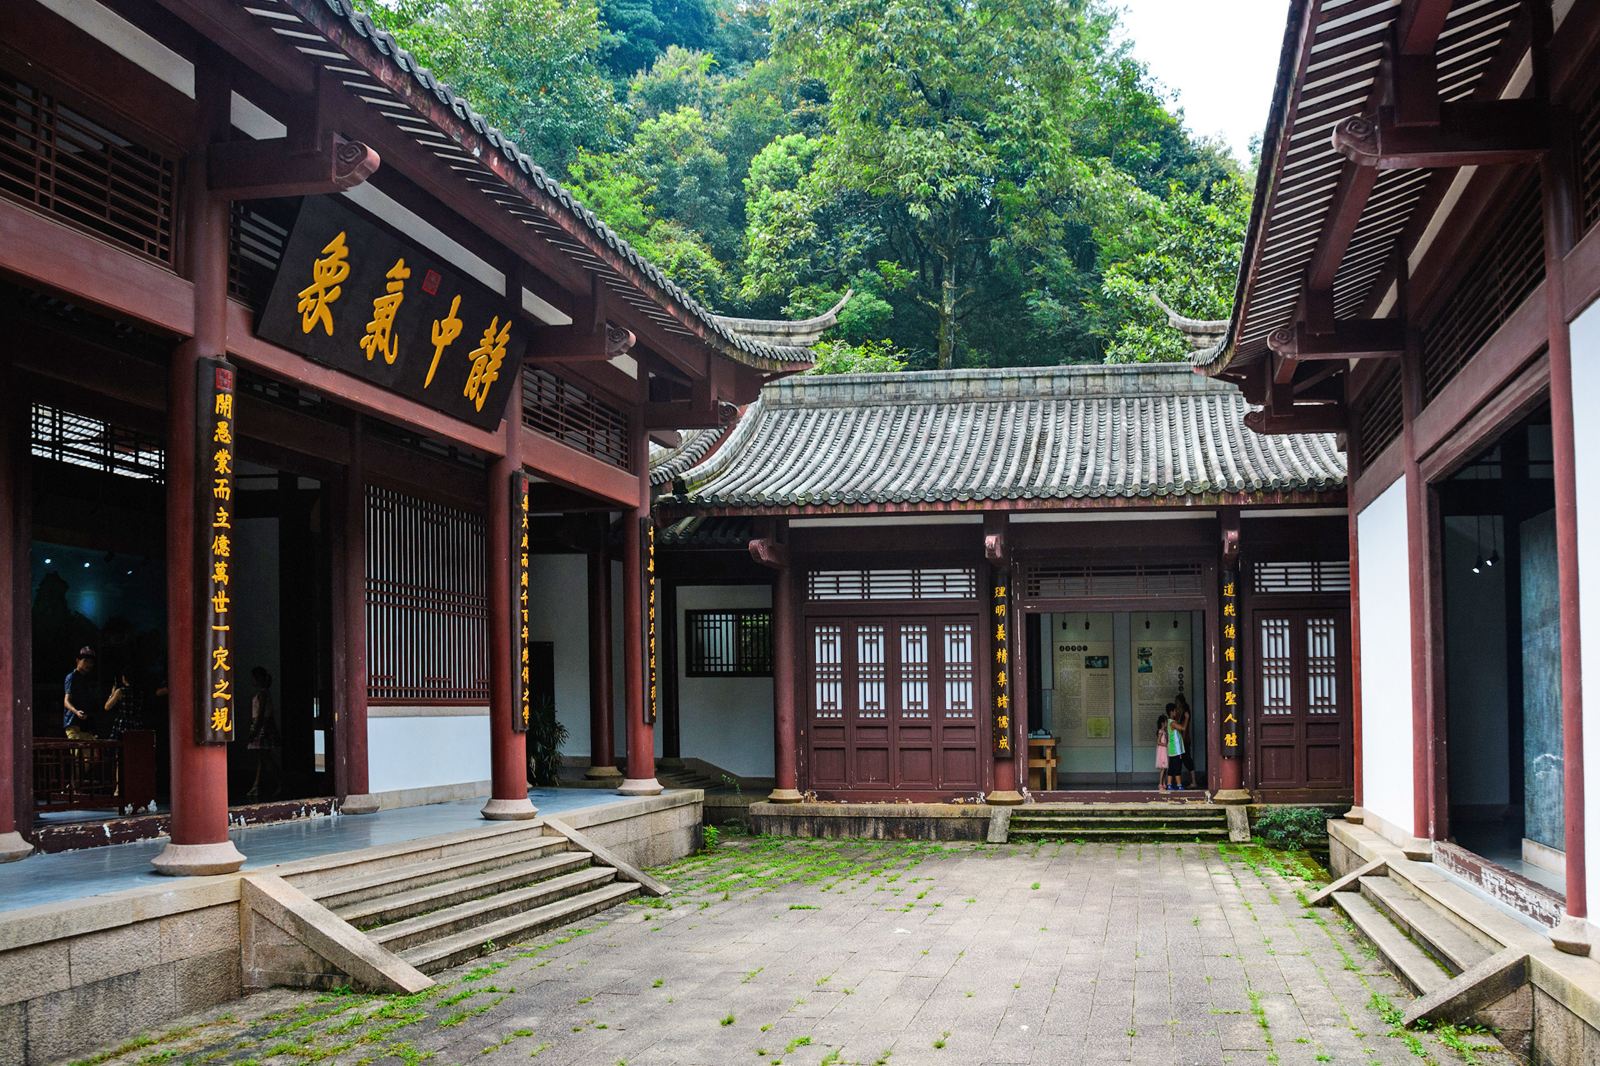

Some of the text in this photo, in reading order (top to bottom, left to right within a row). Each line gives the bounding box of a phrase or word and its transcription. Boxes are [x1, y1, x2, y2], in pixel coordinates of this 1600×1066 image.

[211, 393, 233, 733] 開愚蒙而立億萬世一定之規
